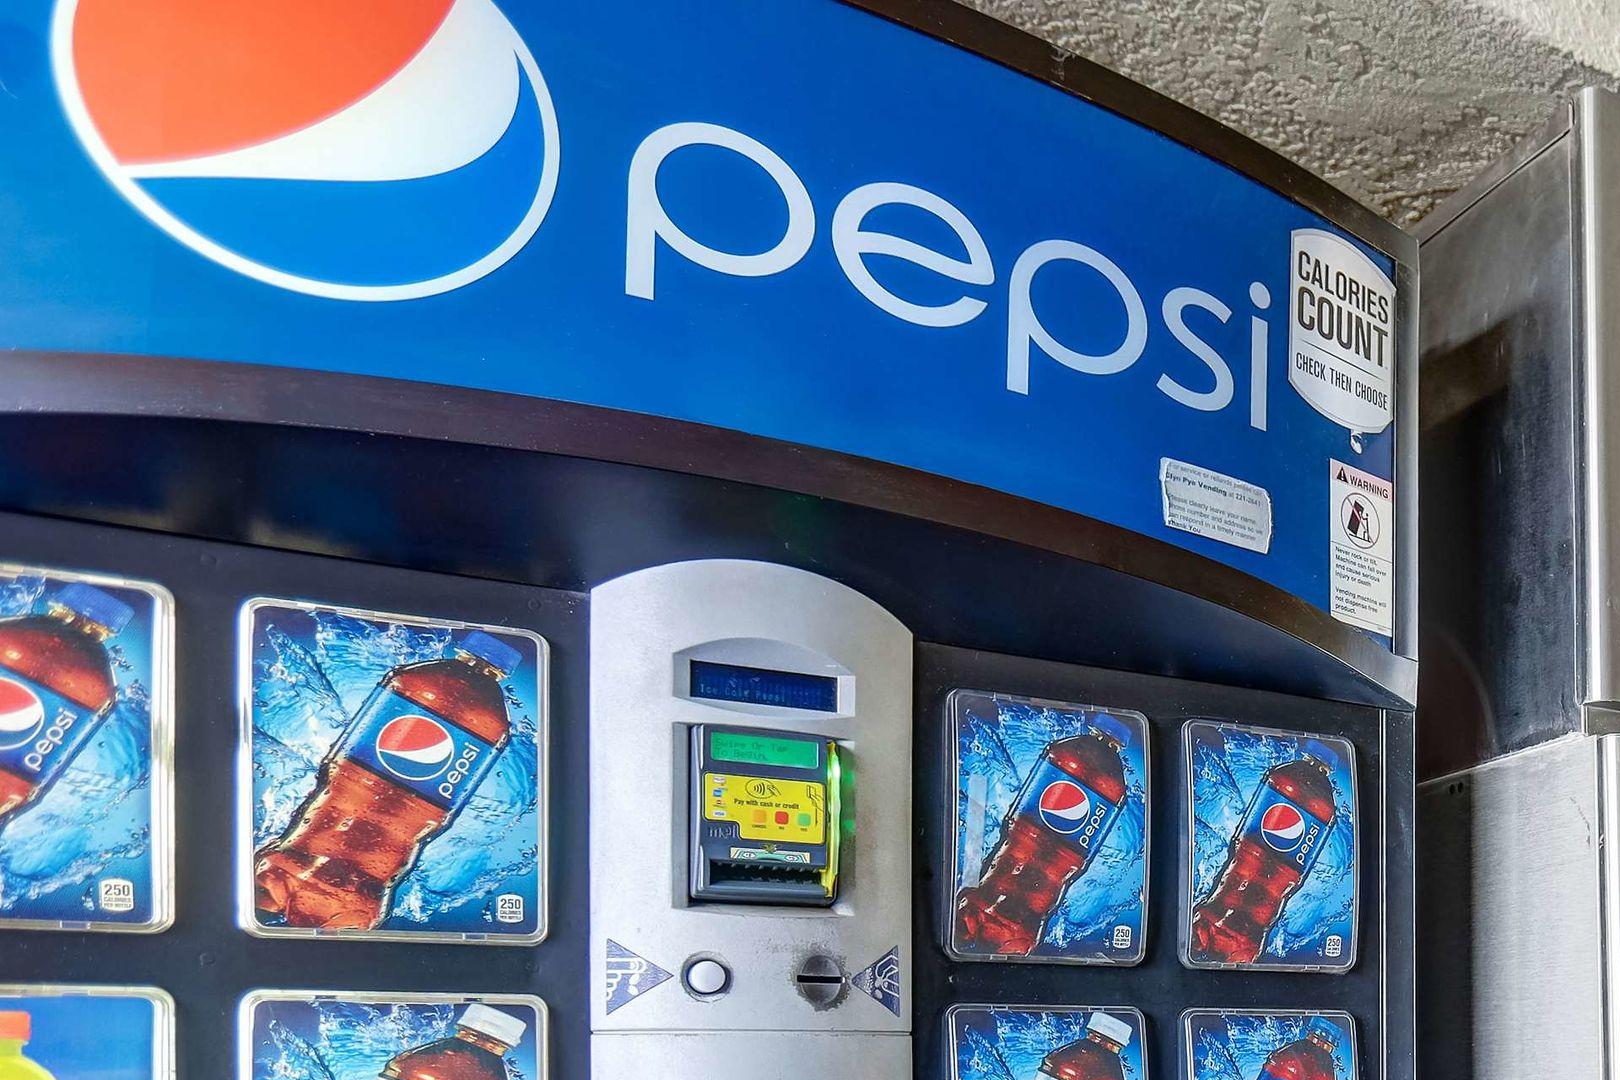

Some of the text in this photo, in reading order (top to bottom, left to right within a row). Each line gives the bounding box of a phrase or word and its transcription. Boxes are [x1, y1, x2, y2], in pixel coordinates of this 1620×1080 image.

[624, 121, 1272, 432] pepsi
[1298, 250, 1389, 325] CALORIES
[1296, 286, 1389, 368] COUNT
[1295, 351, 1388, 411] CHECK THEN CHOOSE
[1349, 474, 1389, 500] WARNING
[24, 706, 78, 772] pepsi
[438, 741, 481, 800] pepsi
[733, 798, 745, 807] Pay
[782, 802, 800, 810] credit
[1079, 801, 1108, 849] pepsi
[1295, 822, 1320, 866] pepsi
[104, 883, 131, 897] 250
[500, 898, 521, 910] 250
[1115, 928, 1130, 938] 250
[1327, 938, 1340, 947] 250
